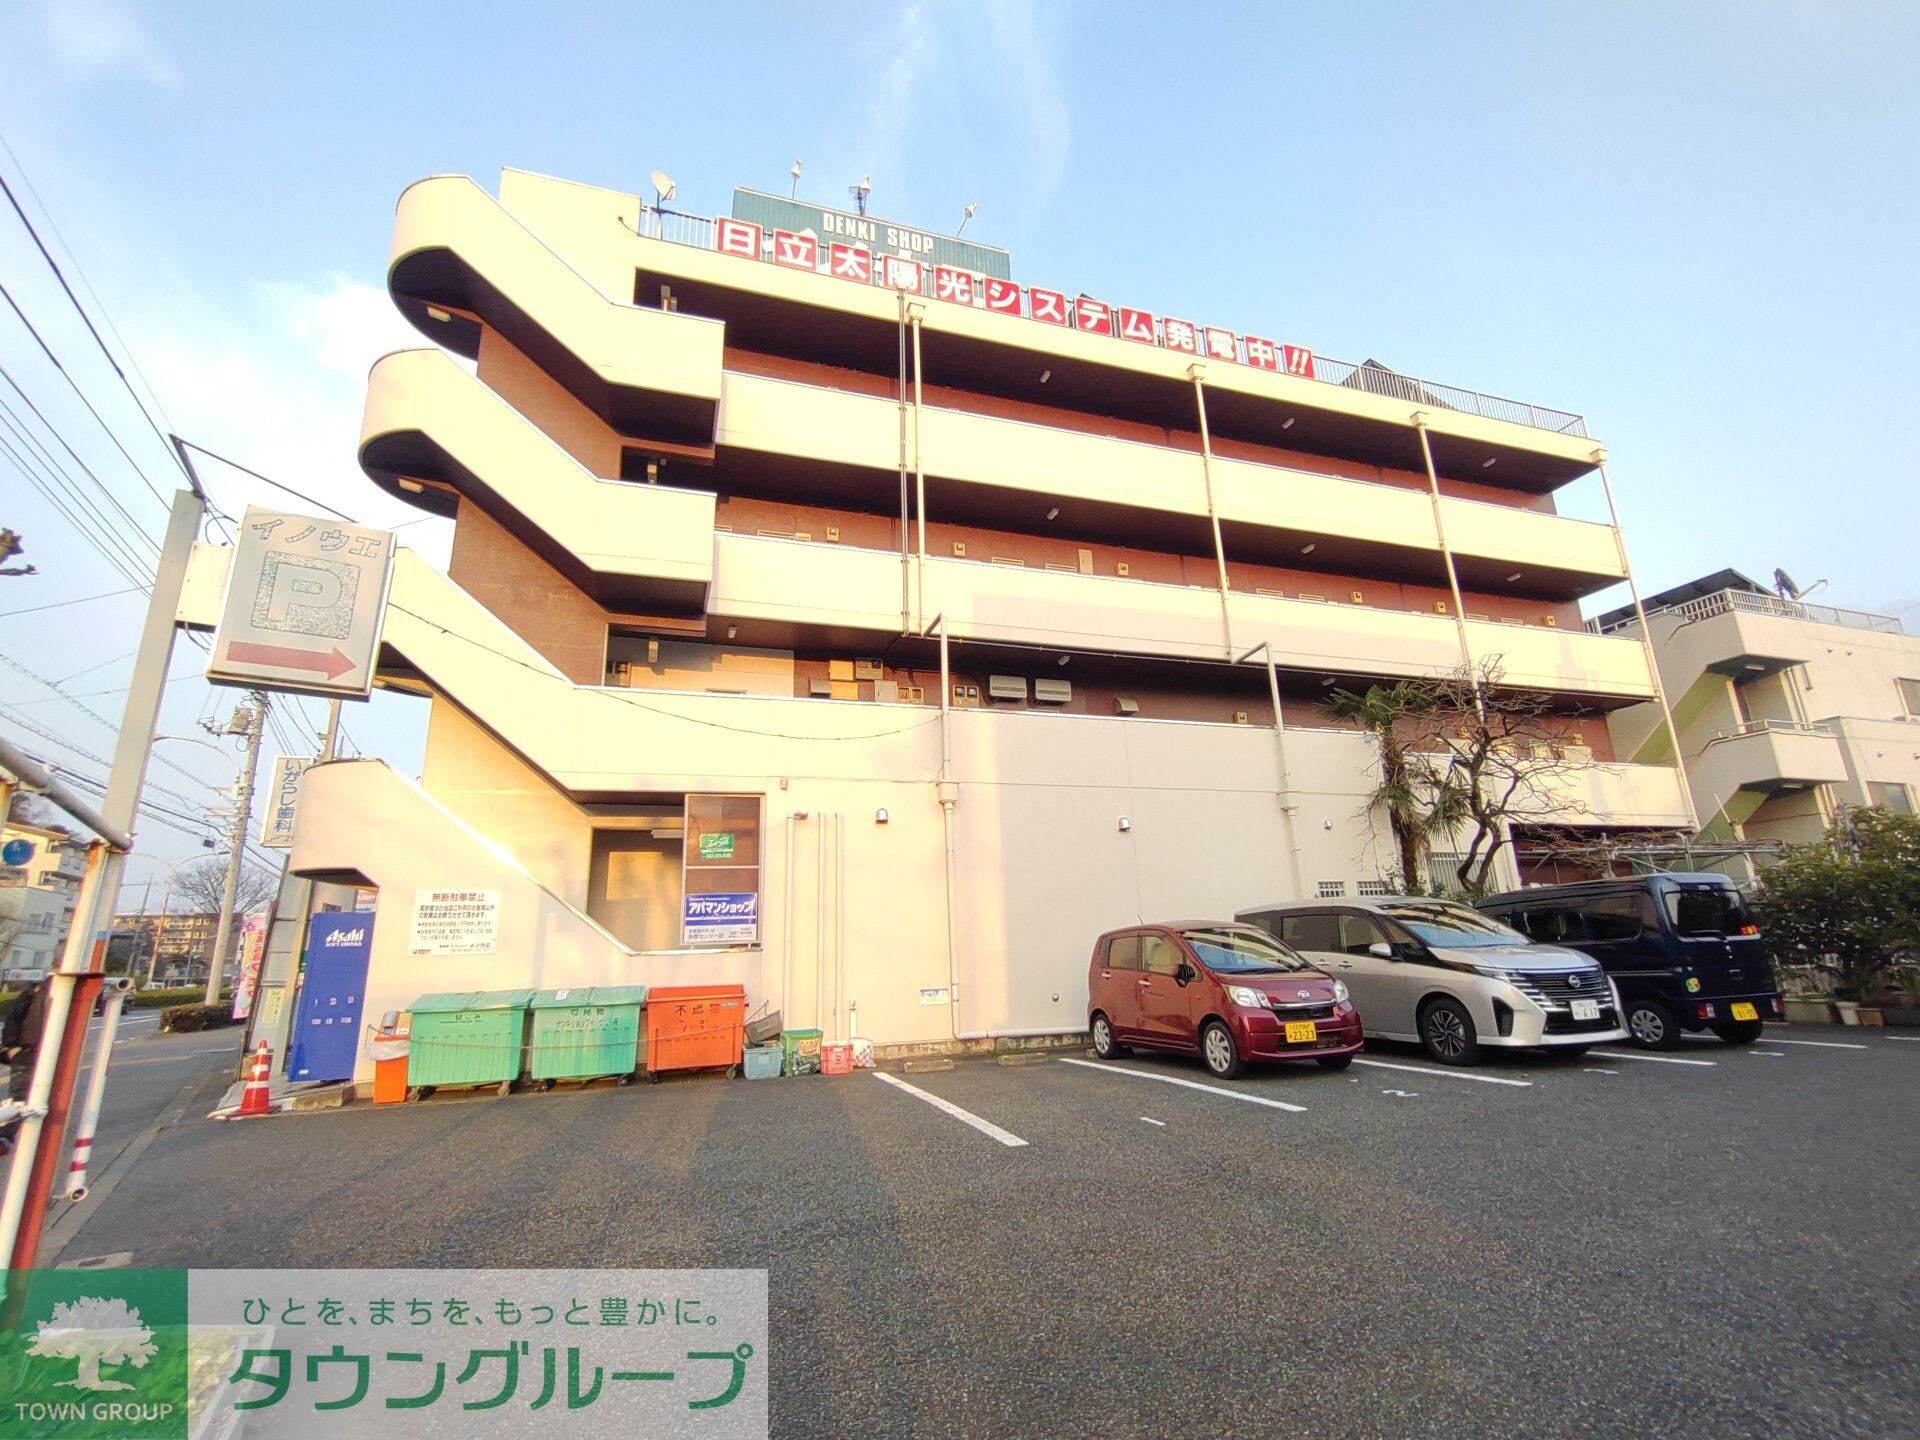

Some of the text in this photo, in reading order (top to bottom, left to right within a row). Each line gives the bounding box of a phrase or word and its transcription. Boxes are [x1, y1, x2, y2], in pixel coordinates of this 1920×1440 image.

[823, 213, 934, 254] DENKI SHOP
[252, 519, 381, 558] イノウエ
[274, 759, 302, 832] いがらし歯科
[688, 901, 755, 915] アパマンショップ
[326, 928, 364, 943] Asahi
